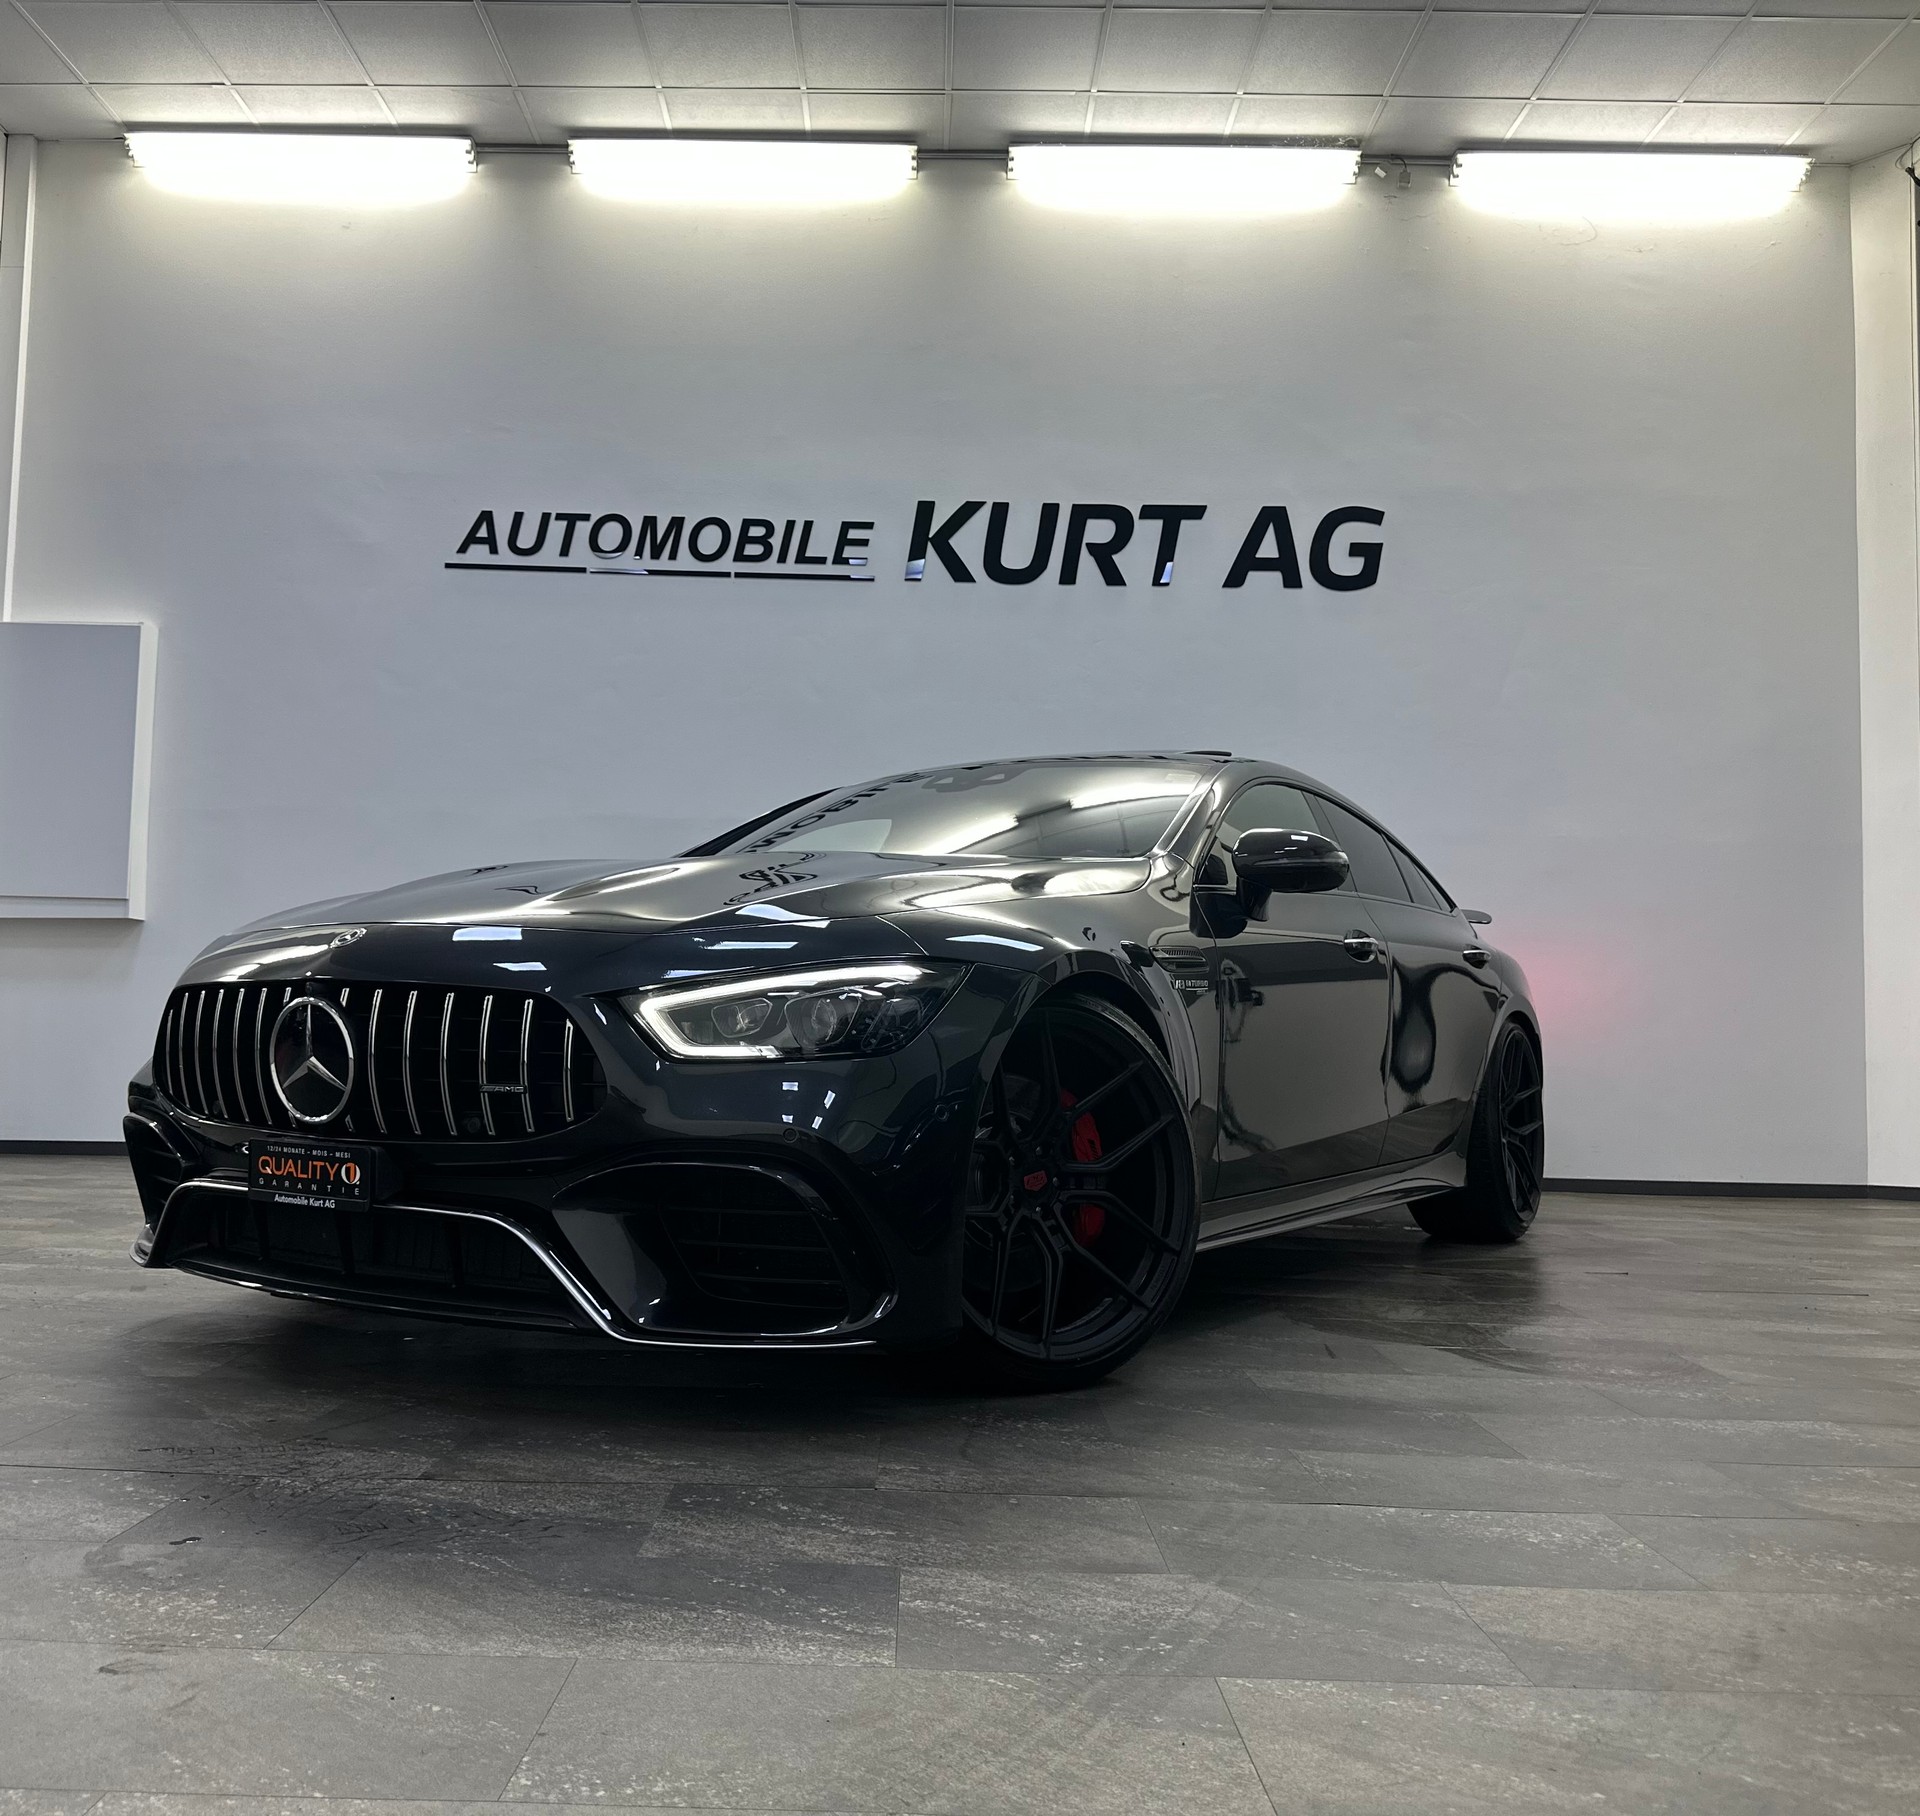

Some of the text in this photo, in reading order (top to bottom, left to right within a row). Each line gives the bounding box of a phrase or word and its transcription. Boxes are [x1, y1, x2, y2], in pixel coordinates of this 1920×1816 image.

[456, 500, 1386, 592] AUTOMOBILE KURT AG
[283, 1147, 305, 1155] MONATE
[258, 1155, 339, 1180] QUALITY
[259, 1178, 359, 1195] GARANTIE
[274, 1194, 335, 1208] Automobile Kurt AG
